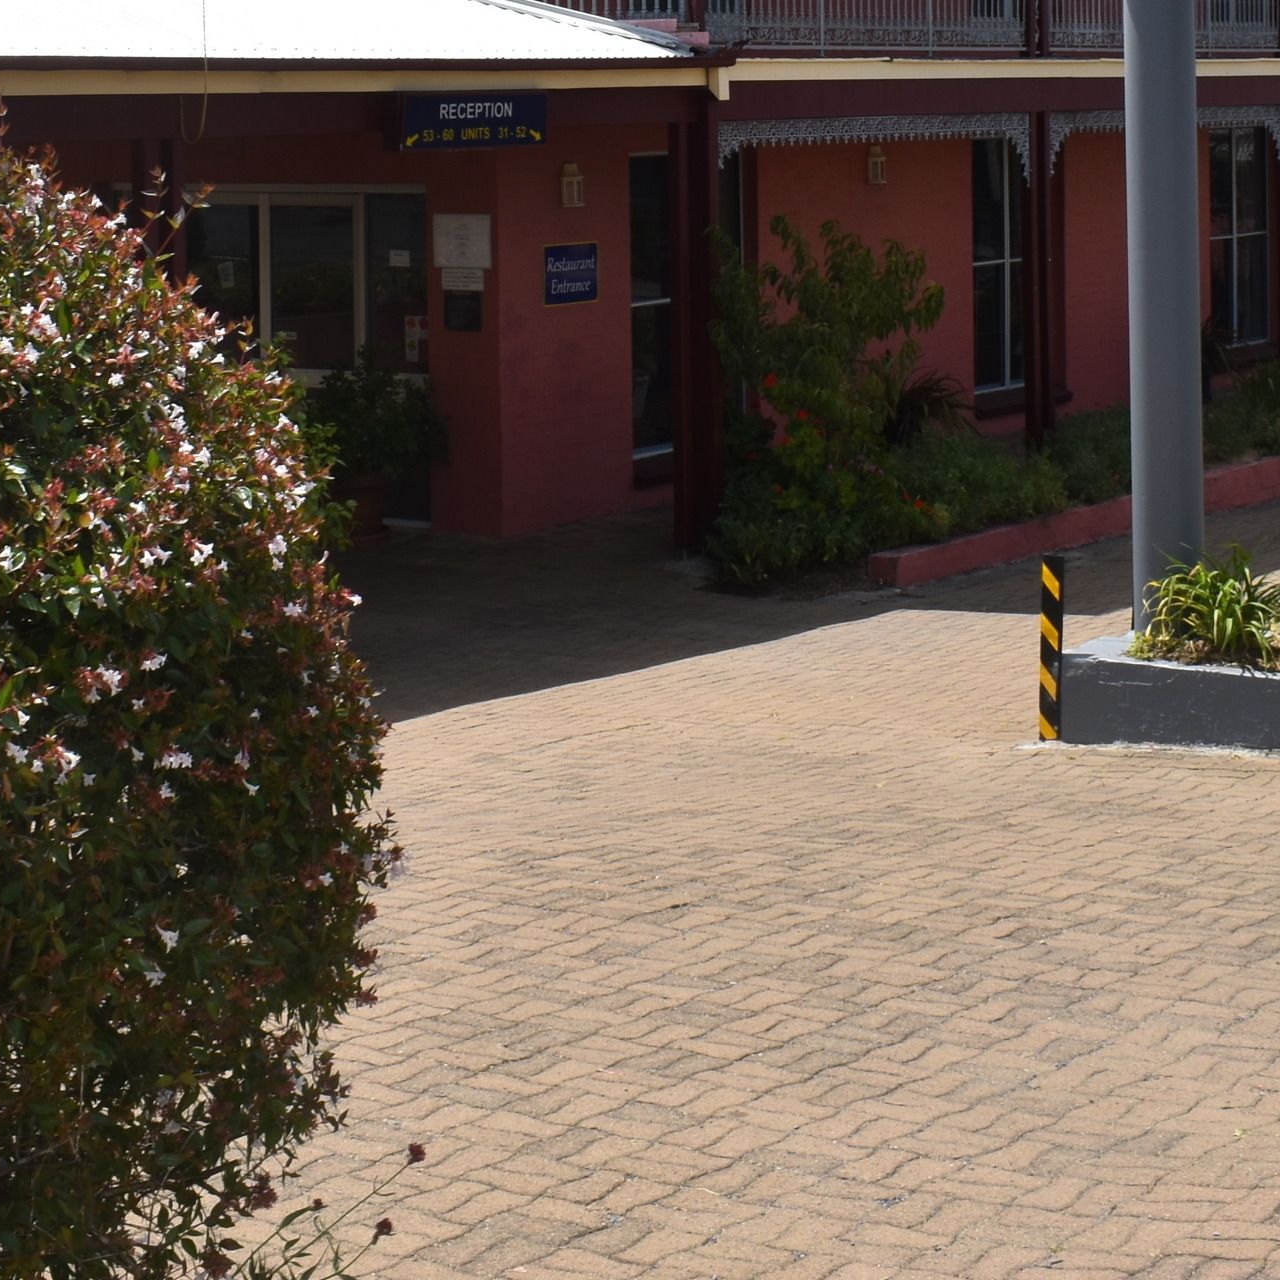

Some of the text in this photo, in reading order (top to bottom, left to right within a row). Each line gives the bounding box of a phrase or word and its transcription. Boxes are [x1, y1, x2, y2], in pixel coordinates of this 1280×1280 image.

[439, 102, 513, 119] RECEPTION
[423, 129, 434, 141] 53
[442, 128, 454, 141] 60
[461, 127, 490, 140] UNITS
[498, 126, 509, 138] 31
[516, 126, 527, 138] 52
[547, 254, 596, 272] Restaurant
[551, 279, 591, 294] Entrance
